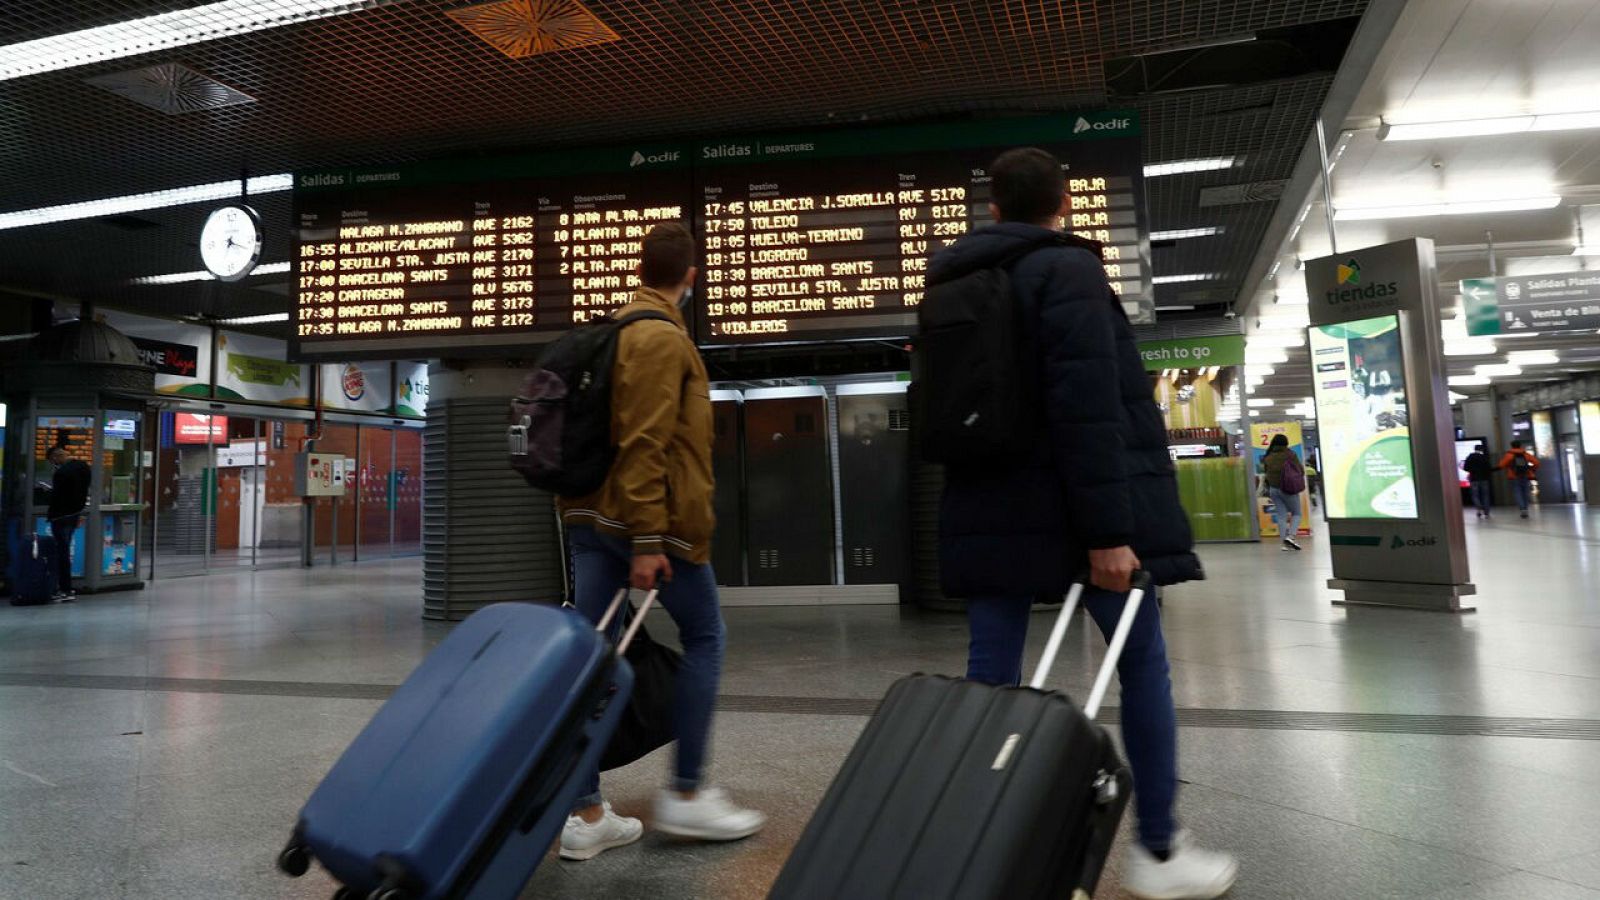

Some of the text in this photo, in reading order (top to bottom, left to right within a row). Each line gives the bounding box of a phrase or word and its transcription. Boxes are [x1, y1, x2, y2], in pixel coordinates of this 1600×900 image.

[1093, 117, 1132, 131] adif
[647, 151, 681, 163] adif
[703, 143, 815, 159] Salidas DEPARTURES
[301, 173, 345, 187] Salidas
[705, 178, 1105, 215] 17:45 VALENCIA J.SOROLLA AVE 5170 BAJA
[706, 195, 1107, 232] 17:50 TOLEDO AV 8172 BAJA
[340, 225, 384, 238] MALAGA
[473, 219, 496, 230] AVE
[503, 216, 533, 229] 2162
[706, 235, 745, 249] 18:05
[750, 228, 863, 246] HUELVA-TERMINO
[900, 224, 925, 237] ALV
[934, 221, 967, 235] 2384
[1072, 212, 1108, 226] BAJA
[301, 244, 336, 256] 16:55
[340, 237, 455, 254] ALICANTE/ALACANT
[473, 235, 496, 246] AVE
[503, 232, 533, 245] 5362
[554, 230, 569, 241] 10
[573, 227, 619, 240] PLANTA
[301, 242, 642, 272] 17:00 SEVILLA STA. JUSTA AVE 2170 7 PLTA.PRIM
[707, 252, 745, 265] 18:15
[901, 241, 926, 254] ALV
[300, 259, 641, 288] 17:00 BARCELONA SANTS AVE 3171 2 PLTA.PRIM
[707, 258, 927, 282] 18:30 BARCELONA SANTS AVE
[300, 275, 641, 304] 17:20 CARTAGENA ALV 5676 PLANTA BA
[707, 285, 746, 299] 19:00
[751, 282, 809, 296] SEVILLA
[815, 280, 847, 293] STA.
[857, 277, 898, 291] JUSTA
[1326, 281, 1397, 305] tiendas
[1528, 277, 1600, 290] Salidas Plant
[299, 291, 635, 319] 17:30 BARCELONA SANTS AVE 3173 PLTA.PRI
[708, 302, 746, 315] 19:00
[752, 298, 825, 313] BARCELONA
[832, 295, 874, 309] SANTS
[1564, 307, 1579, 316] de
[299, 323, 334, 335] 17:35
[337, 321, 382, 333] MALAGA
[472, 315, 495, 327] AVE
[502, 314, 533, 325] 2172
[1141, 347, 1210, 360] resh to go
[415, 380, 430, 396] tie
